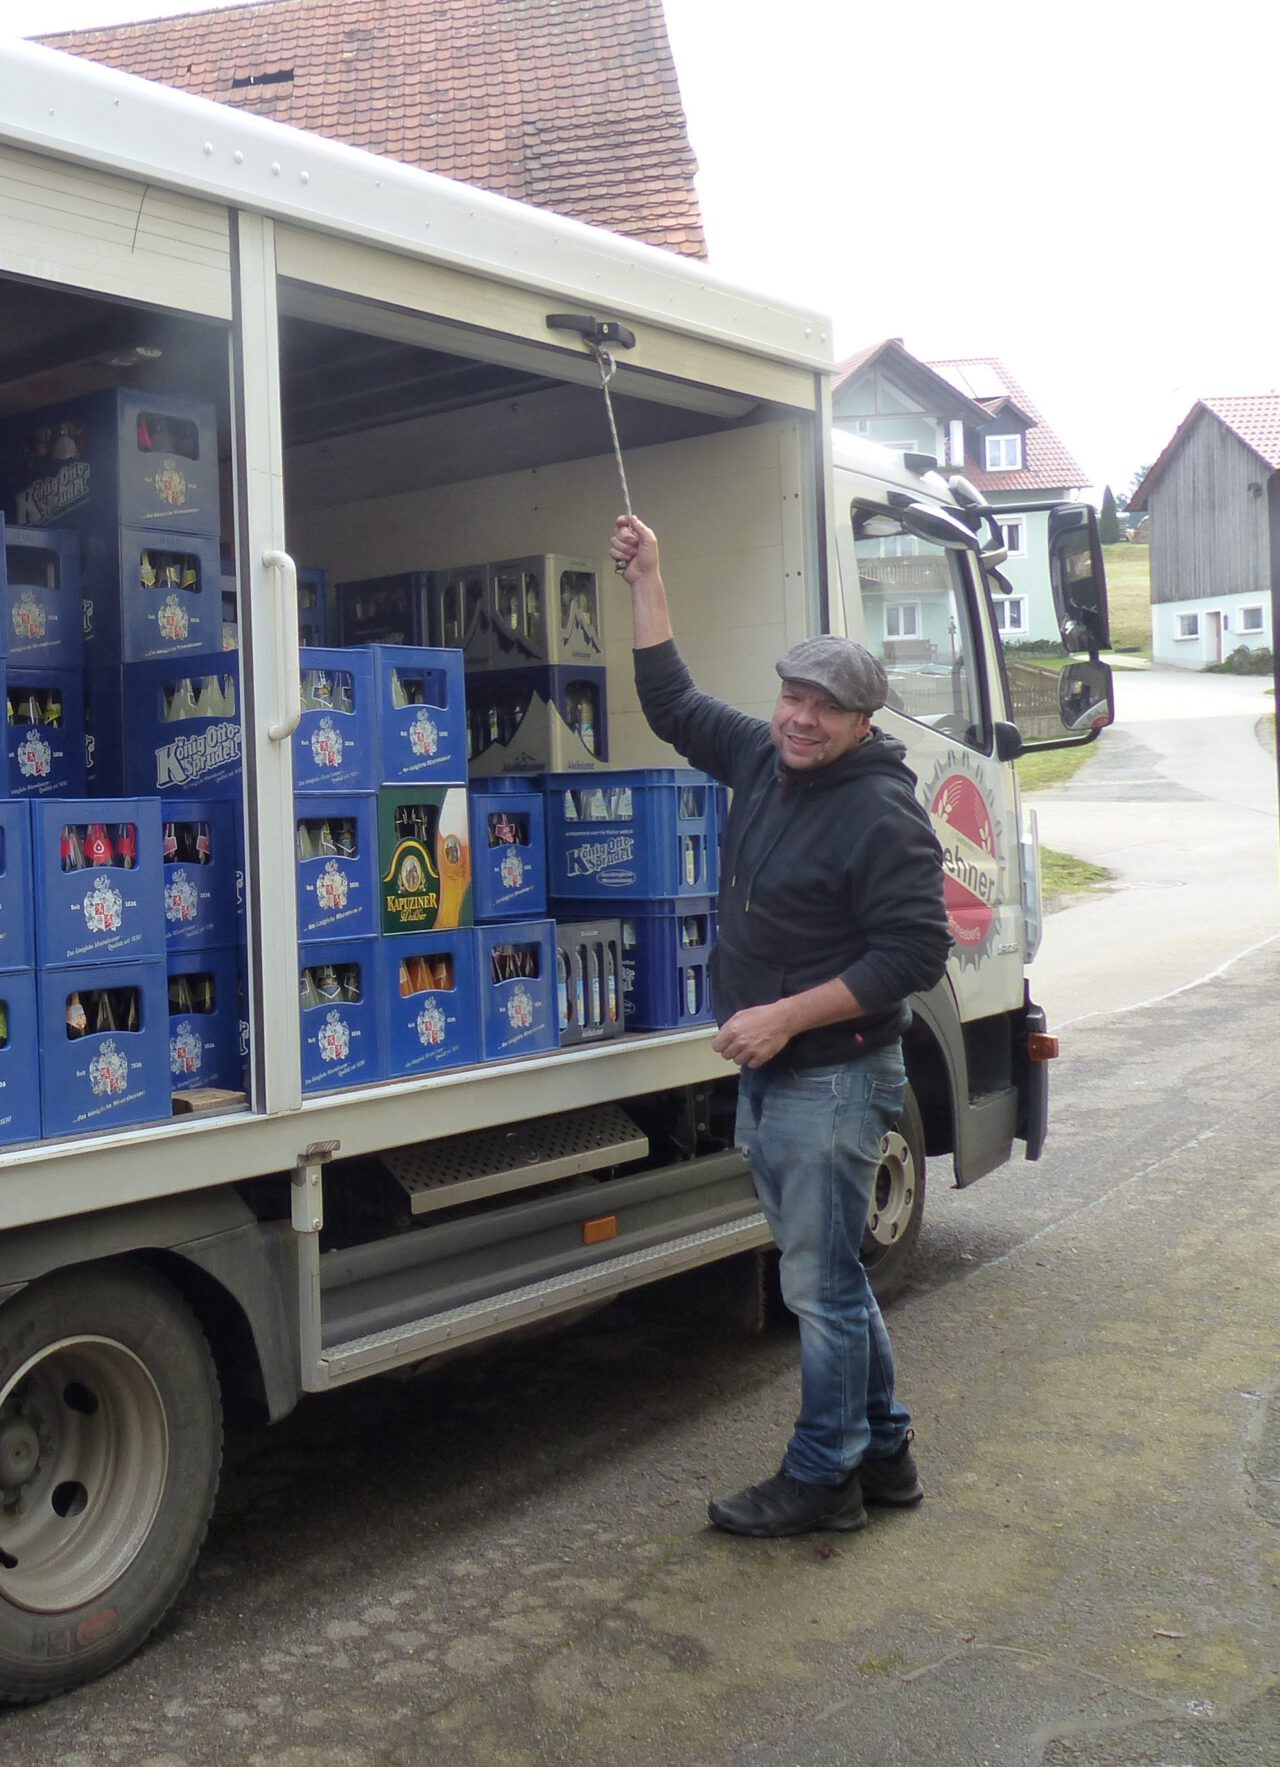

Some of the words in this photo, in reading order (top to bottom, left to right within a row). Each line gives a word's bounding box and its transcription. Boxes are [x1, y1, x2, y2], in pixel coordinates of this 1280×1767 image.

[155, 735, 207, 789] König
[181, 737, 241, 779] Sprudel
[943, 845, 995, 902] ehner
[386, 892, 438, 913] KAPUZINER
